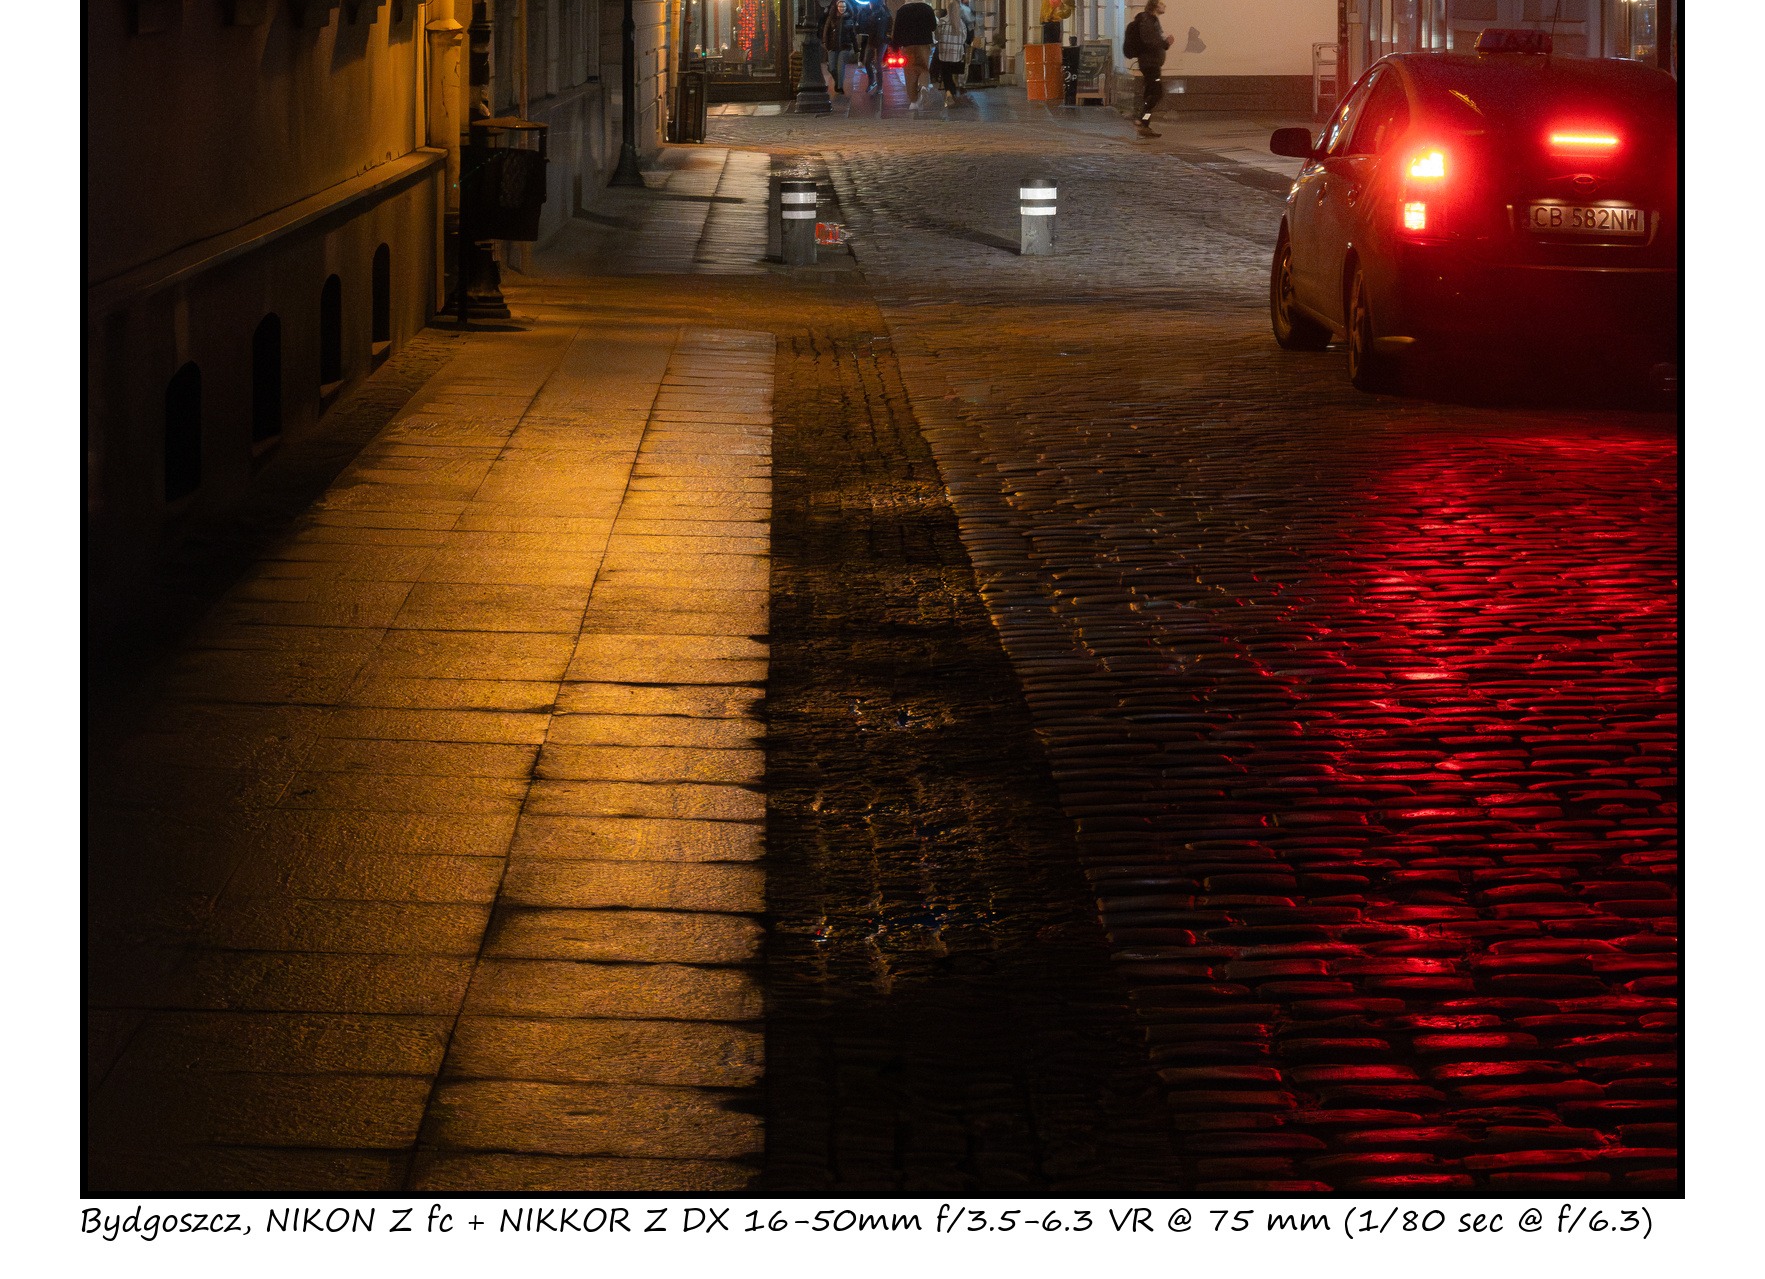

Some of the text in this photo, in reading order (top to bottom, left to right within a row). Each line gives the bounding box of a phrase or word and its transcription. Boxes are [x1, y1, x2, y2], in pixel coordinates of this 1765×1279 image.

[1491, 32, 1543, 49] TAXI
[1535, 207, 1639, 231] CB 582NW
